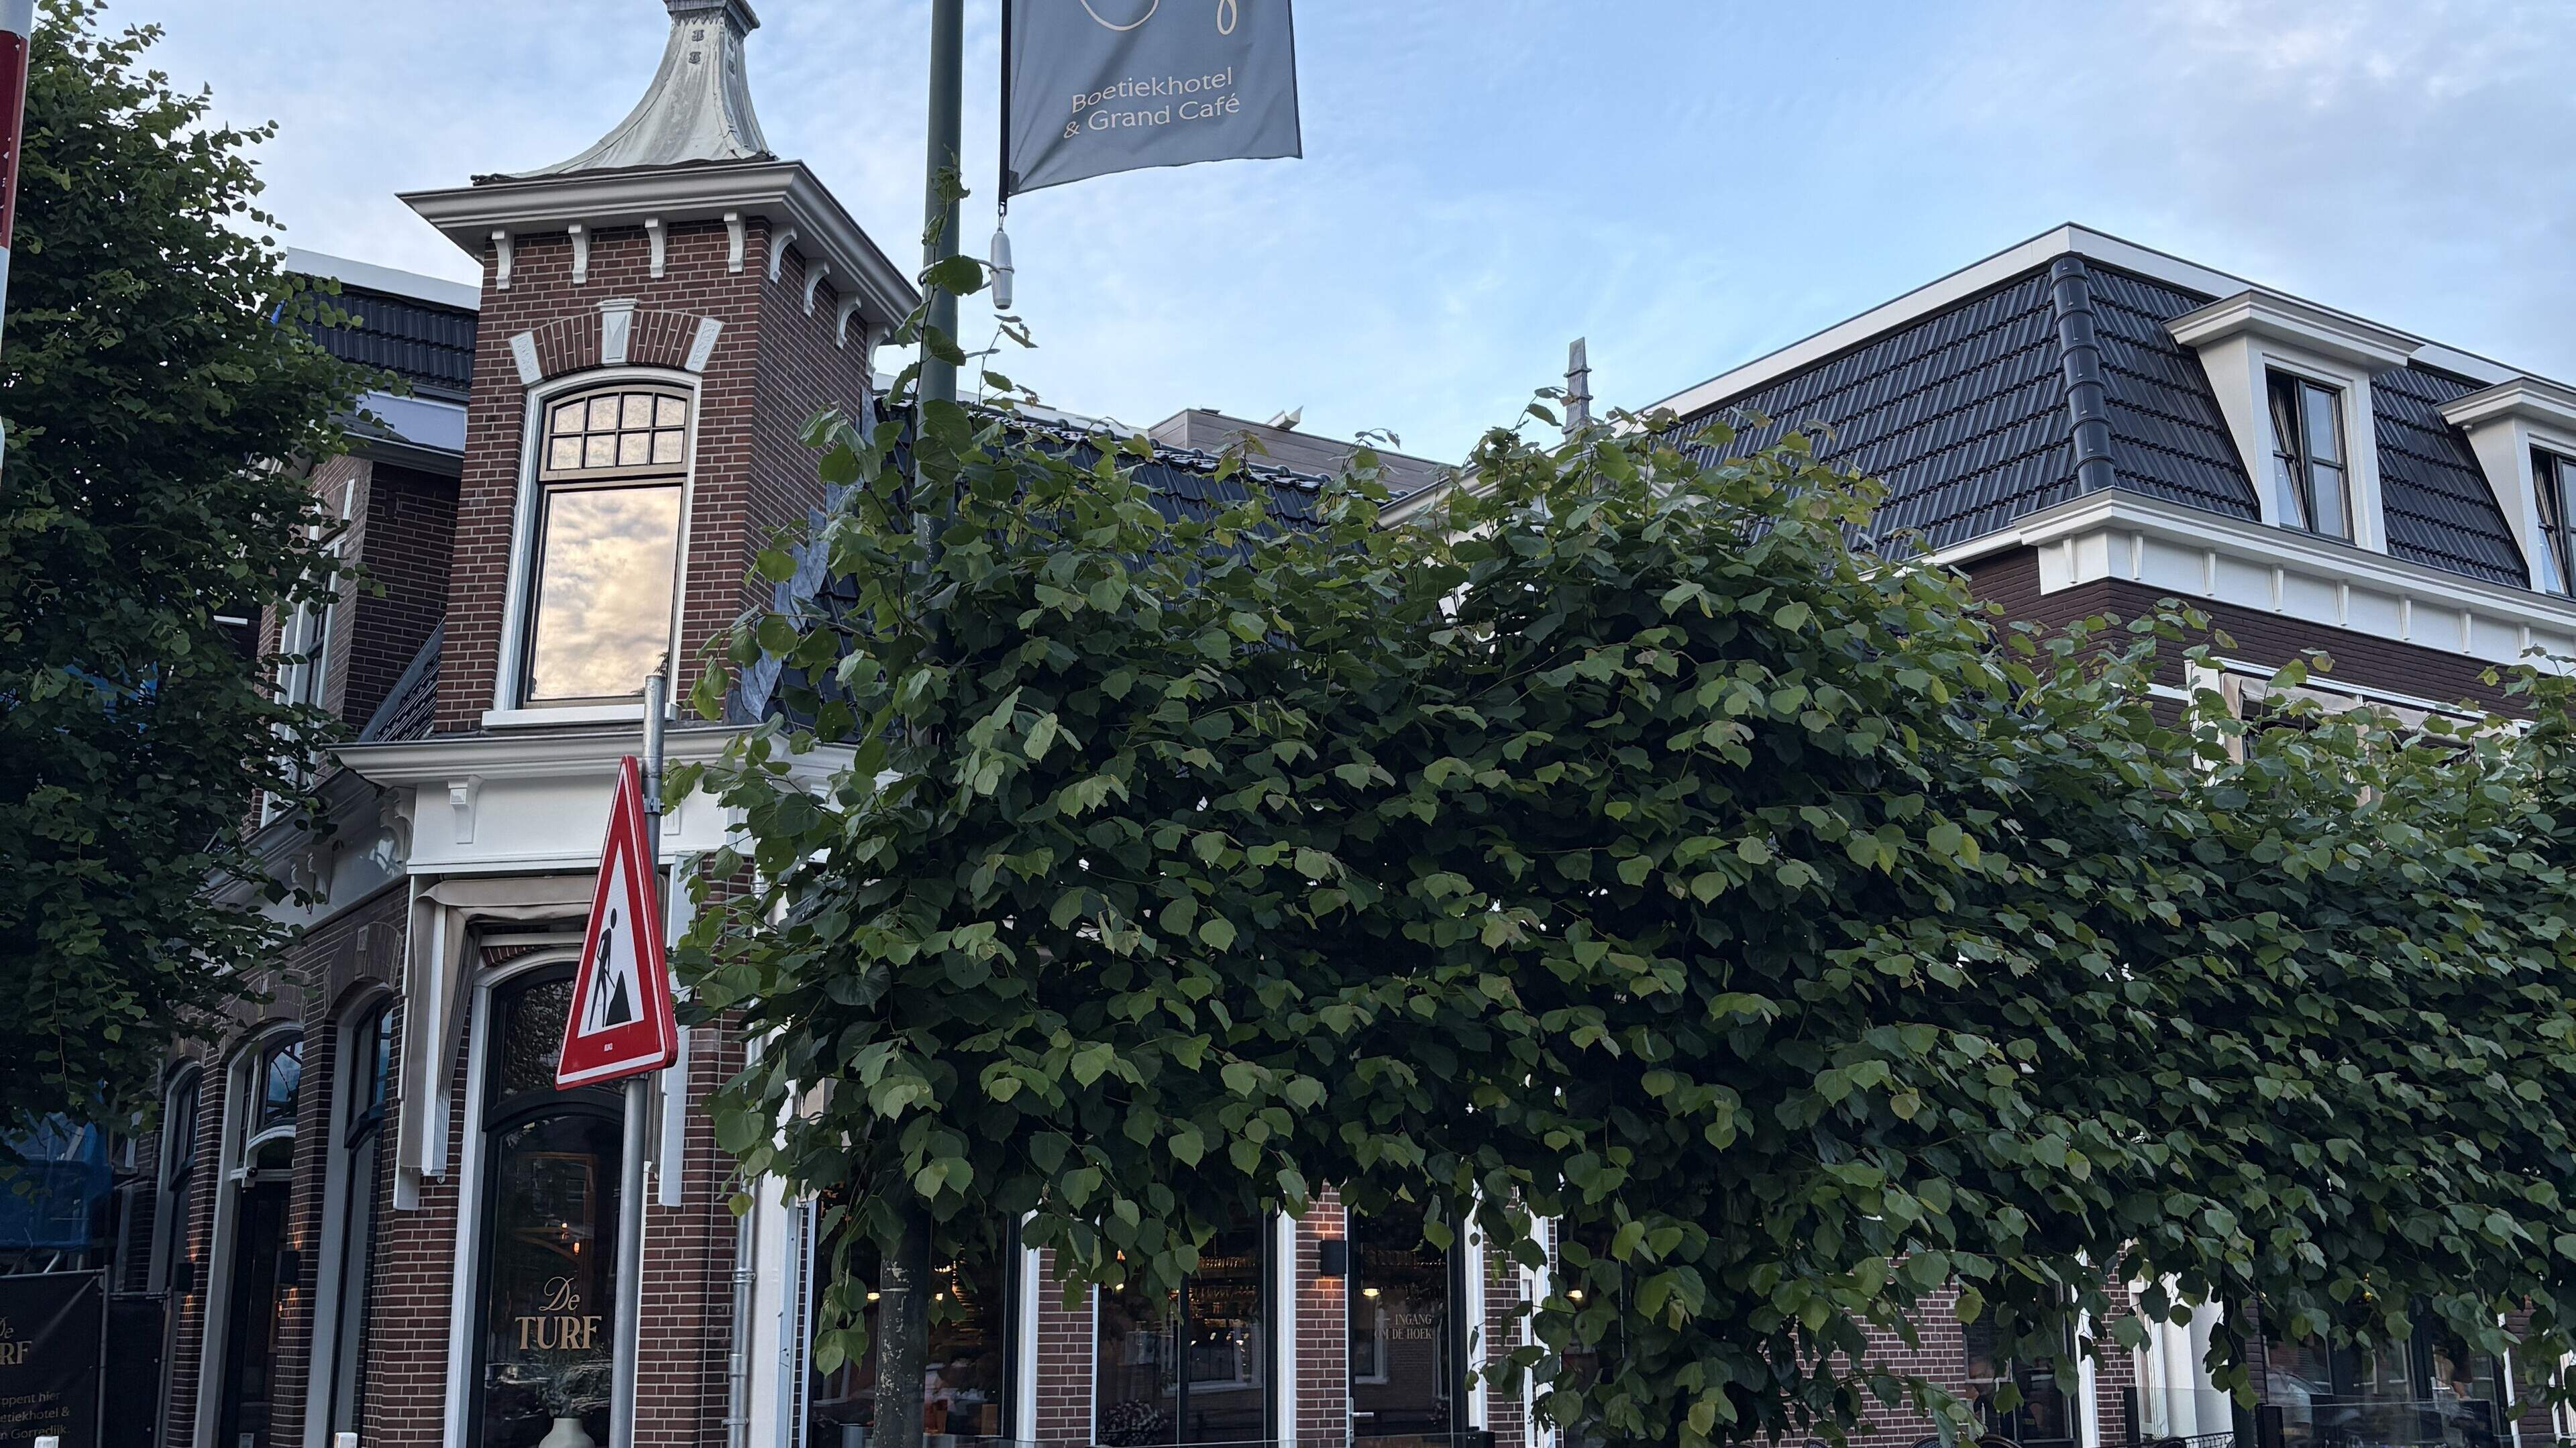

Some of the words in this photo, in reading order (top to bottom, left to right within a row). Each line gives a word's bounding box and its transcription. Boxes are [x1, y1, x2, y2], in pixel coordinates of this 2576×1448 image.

[1072, 67, 1232, 113] Boetiekhotel
[1063, 120, 1080, 139] &
[1088, 105, 1170, 131] Grand
[1178, 93, 1240, 120] Café
[539, 1276, 580, 1311] De
[1395, 1314, 1432, 1325] INGANG
[515, 1315, 602, 1349] TURF
[1375, 1329, 1389, 1340] OM
[1392, 1328, 1404, 1340] DE
[1407, 1328, 1432, 1339] HOEK
[38, 1392, 61, 1402] hier
[61, 1406, 70, 1416] &
